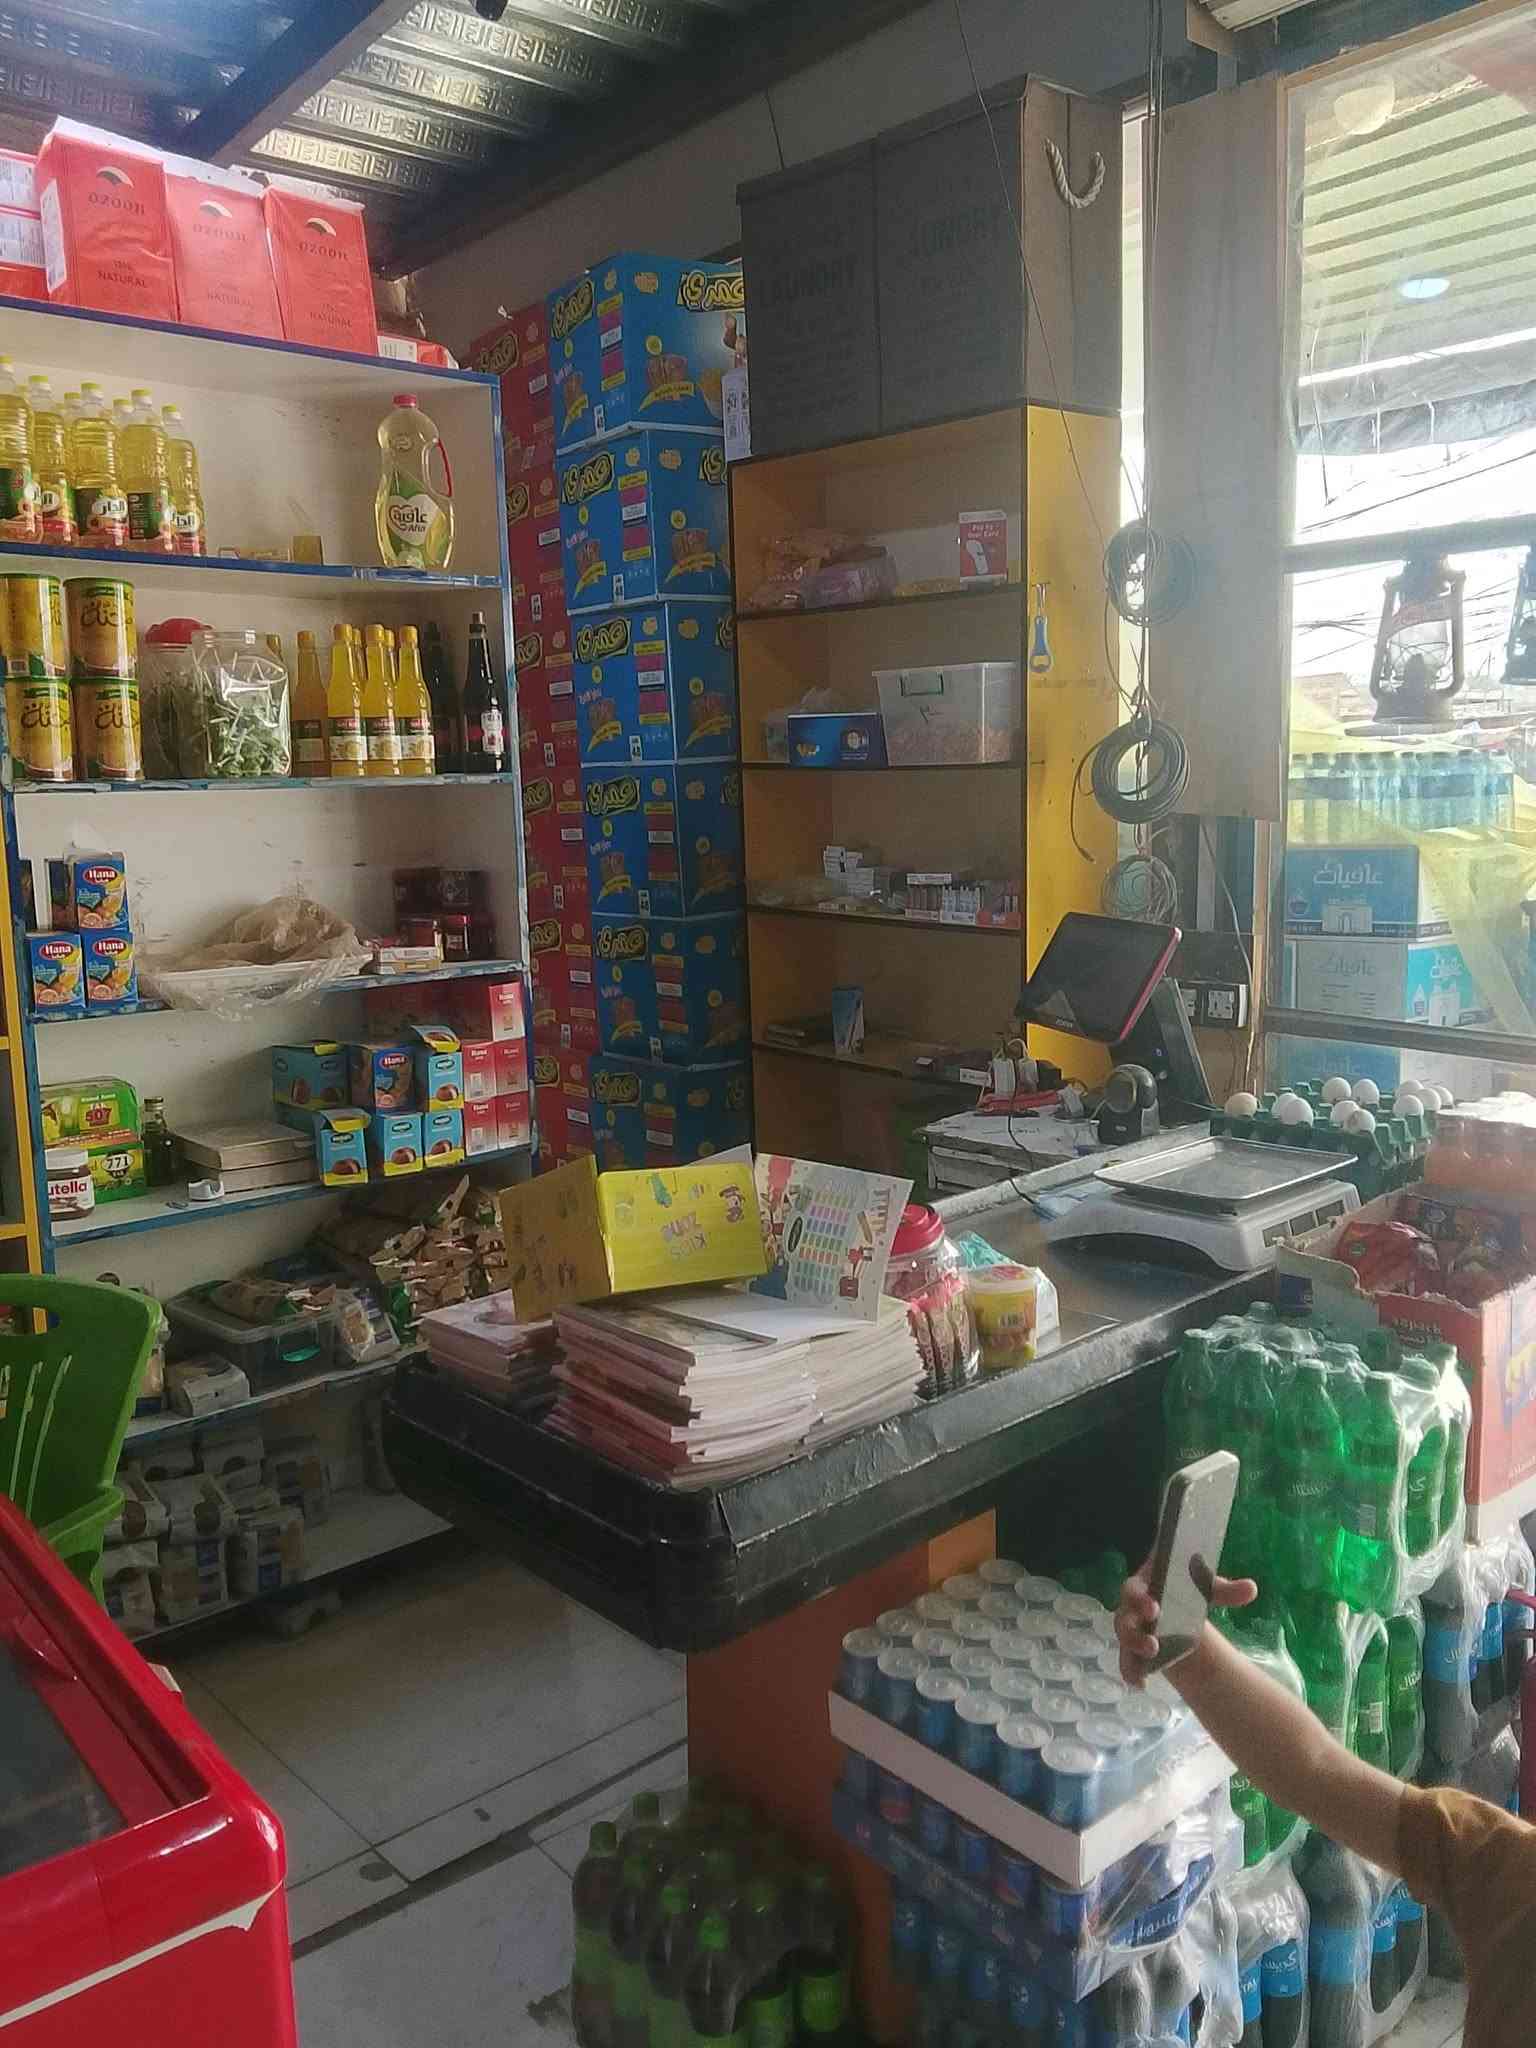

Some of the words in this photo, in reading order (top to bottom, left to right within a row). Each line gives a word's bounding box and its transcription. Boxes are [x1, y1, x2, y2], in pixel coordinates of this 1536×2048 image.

[393, 507, 428, 524] عافية
[88, 869, 115, 879] Hana
[45, 944, 72, 955] Hana
[98, 940, 124, 951] Hana
[106, 1156, 128, 1169] 771
[48, 1181, 87, 1196] utella
